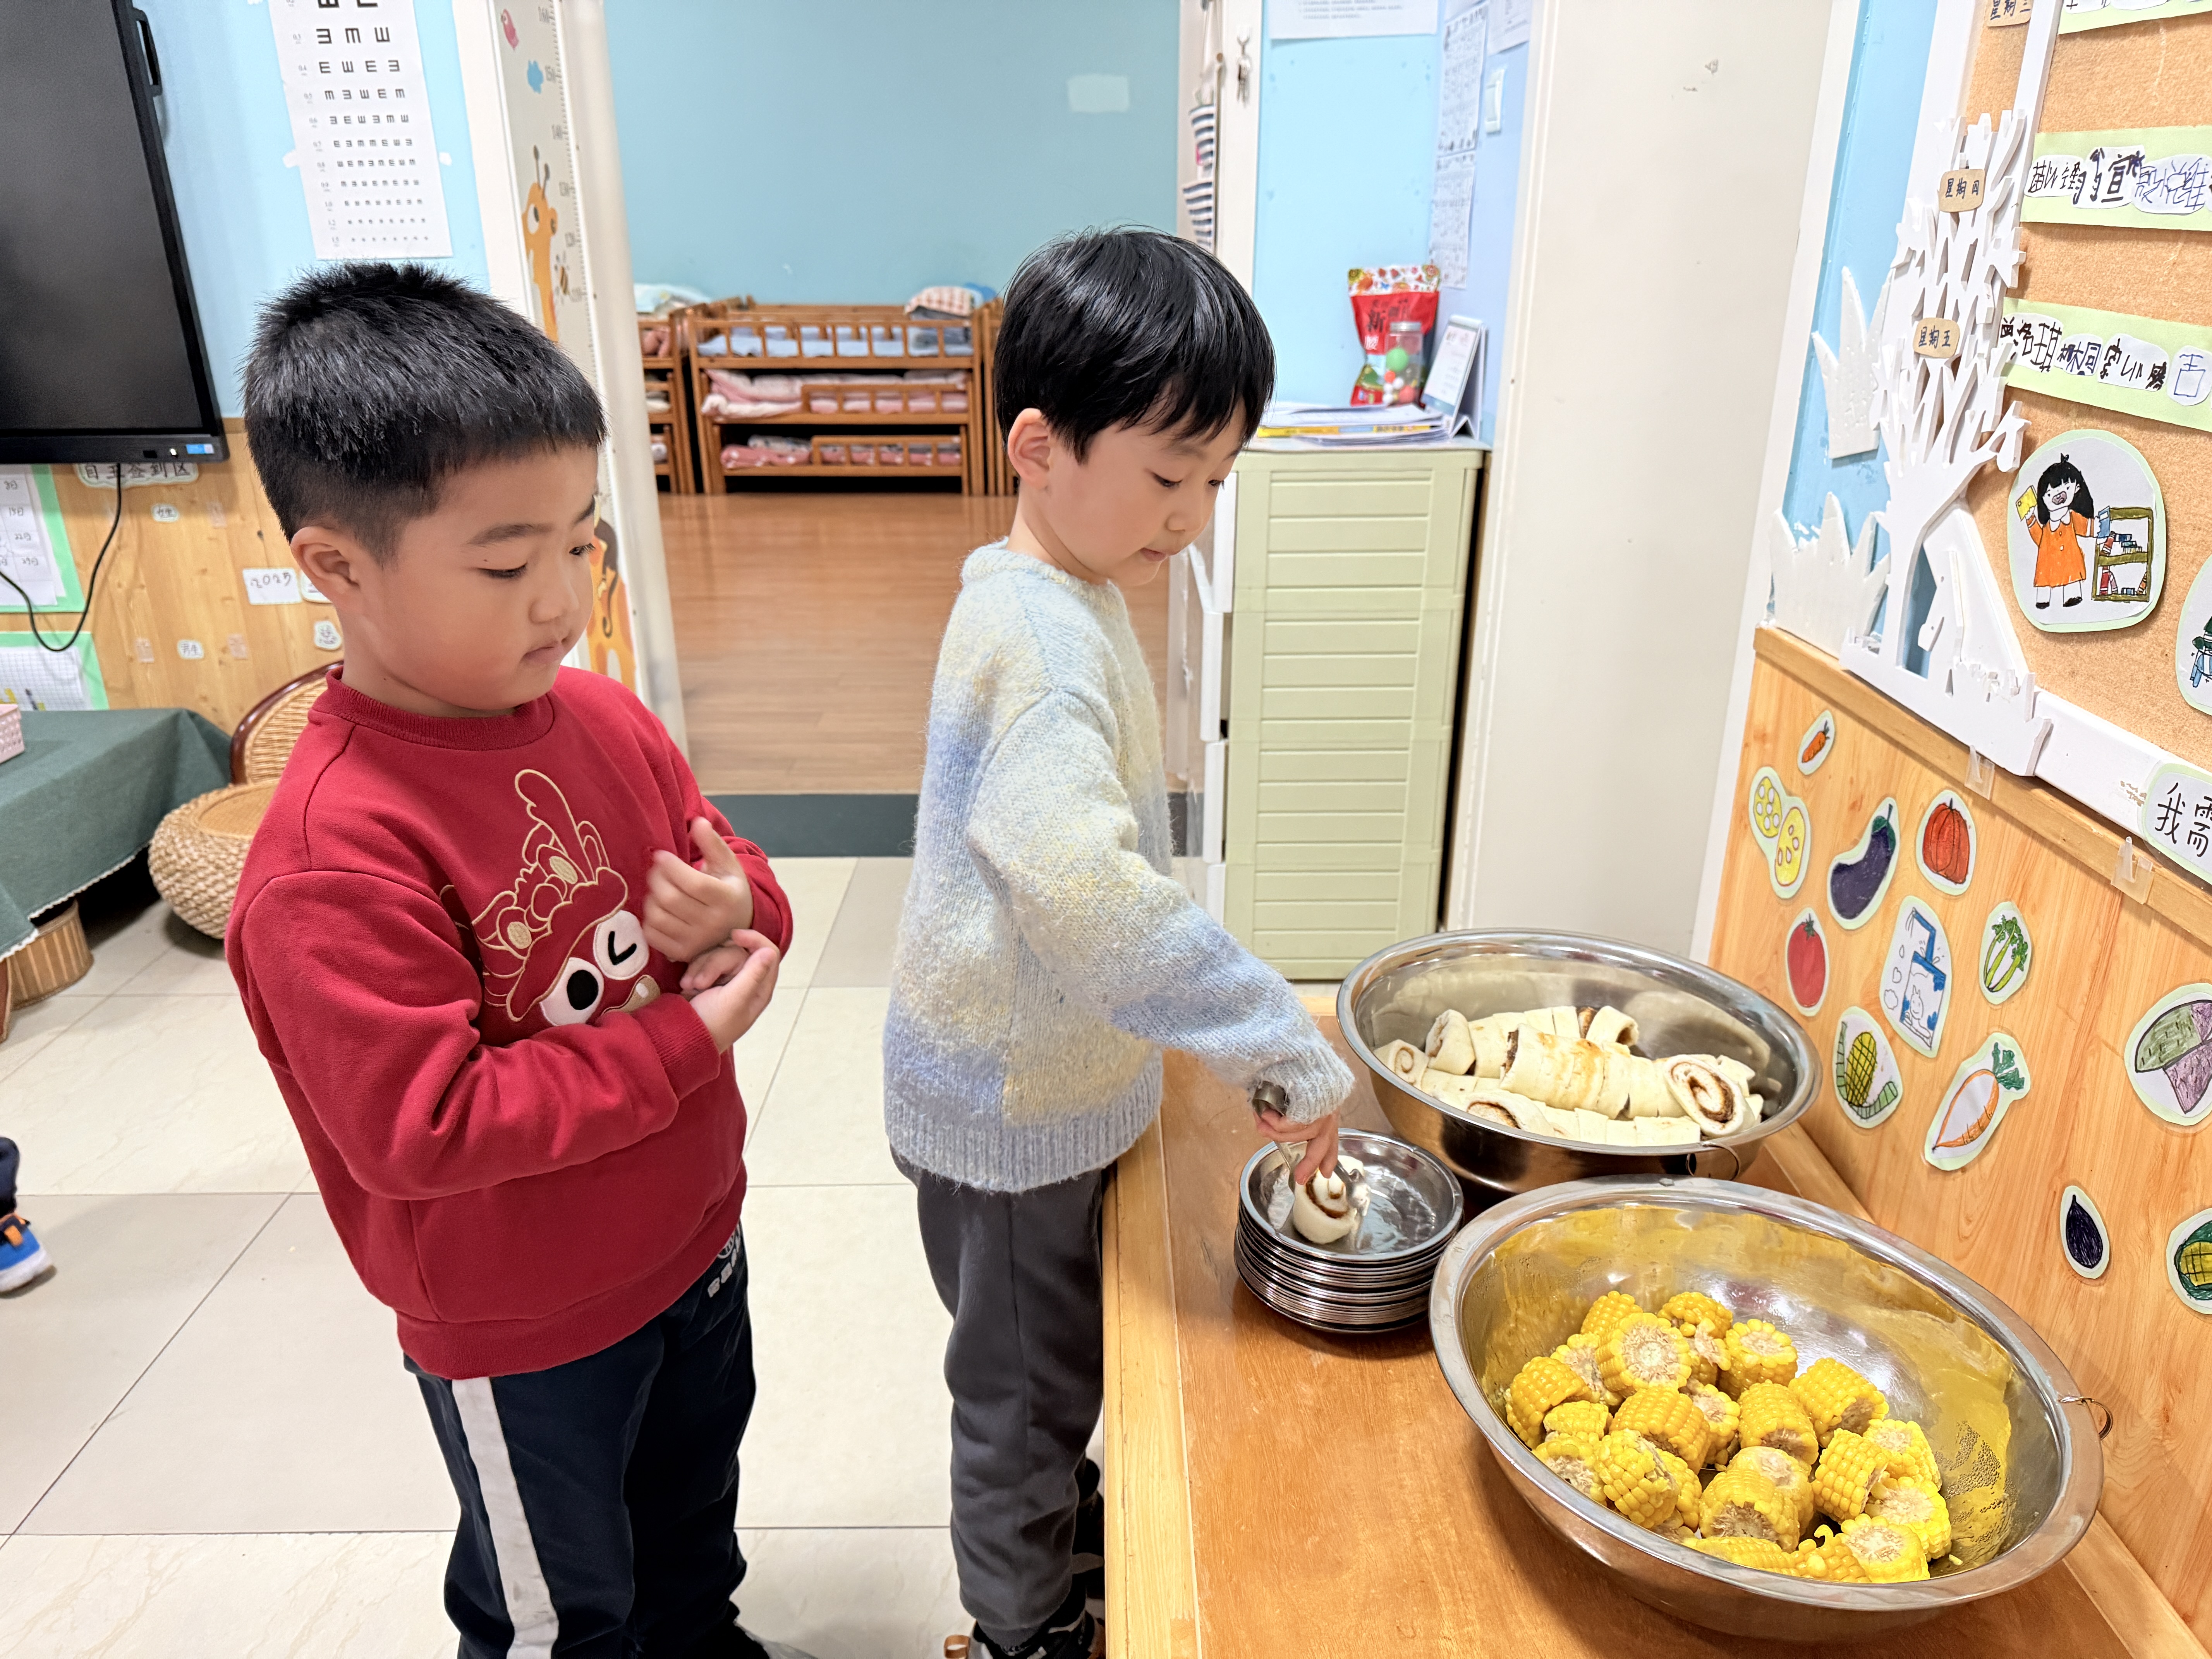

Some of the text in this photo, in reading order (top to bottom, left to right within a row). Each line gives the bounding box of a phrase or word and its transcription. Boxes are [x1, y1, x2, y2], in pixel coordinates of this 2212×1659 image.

[1945, 177, 1980, 199] 星期四
[1918, 325, 1951, 349] 星期五
[250, 572, 291, 589] 2025
[2155, 782, 2212, 857] 我需
